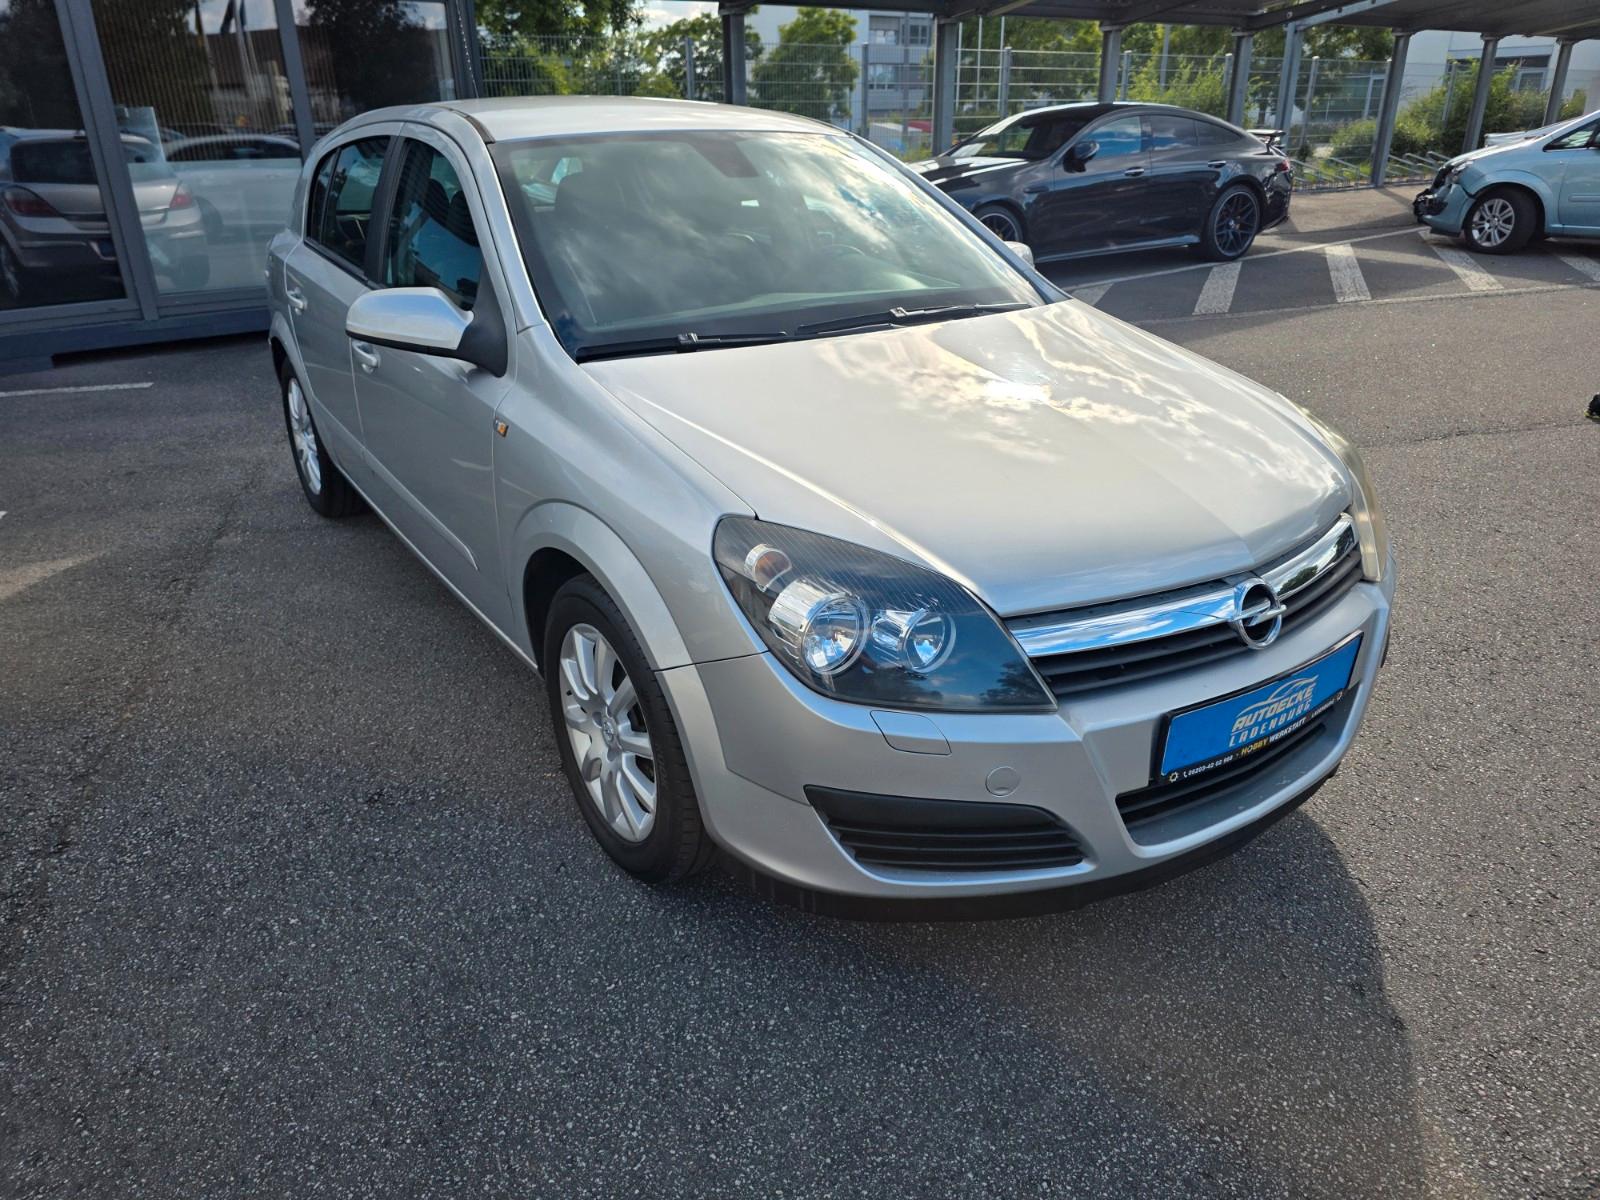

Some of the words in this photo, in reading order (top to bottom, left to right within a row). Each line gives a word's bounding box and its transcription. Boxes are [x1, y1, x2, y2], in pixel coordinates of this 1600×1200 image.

[1229, 699, 1311, 747] LADENBURG
[1231, 686, 1314, 732] AUTOECKE
[1241, 738, 1268, 757] HOBBY
[1269, 717, 1306, 742] WERKSTATT
